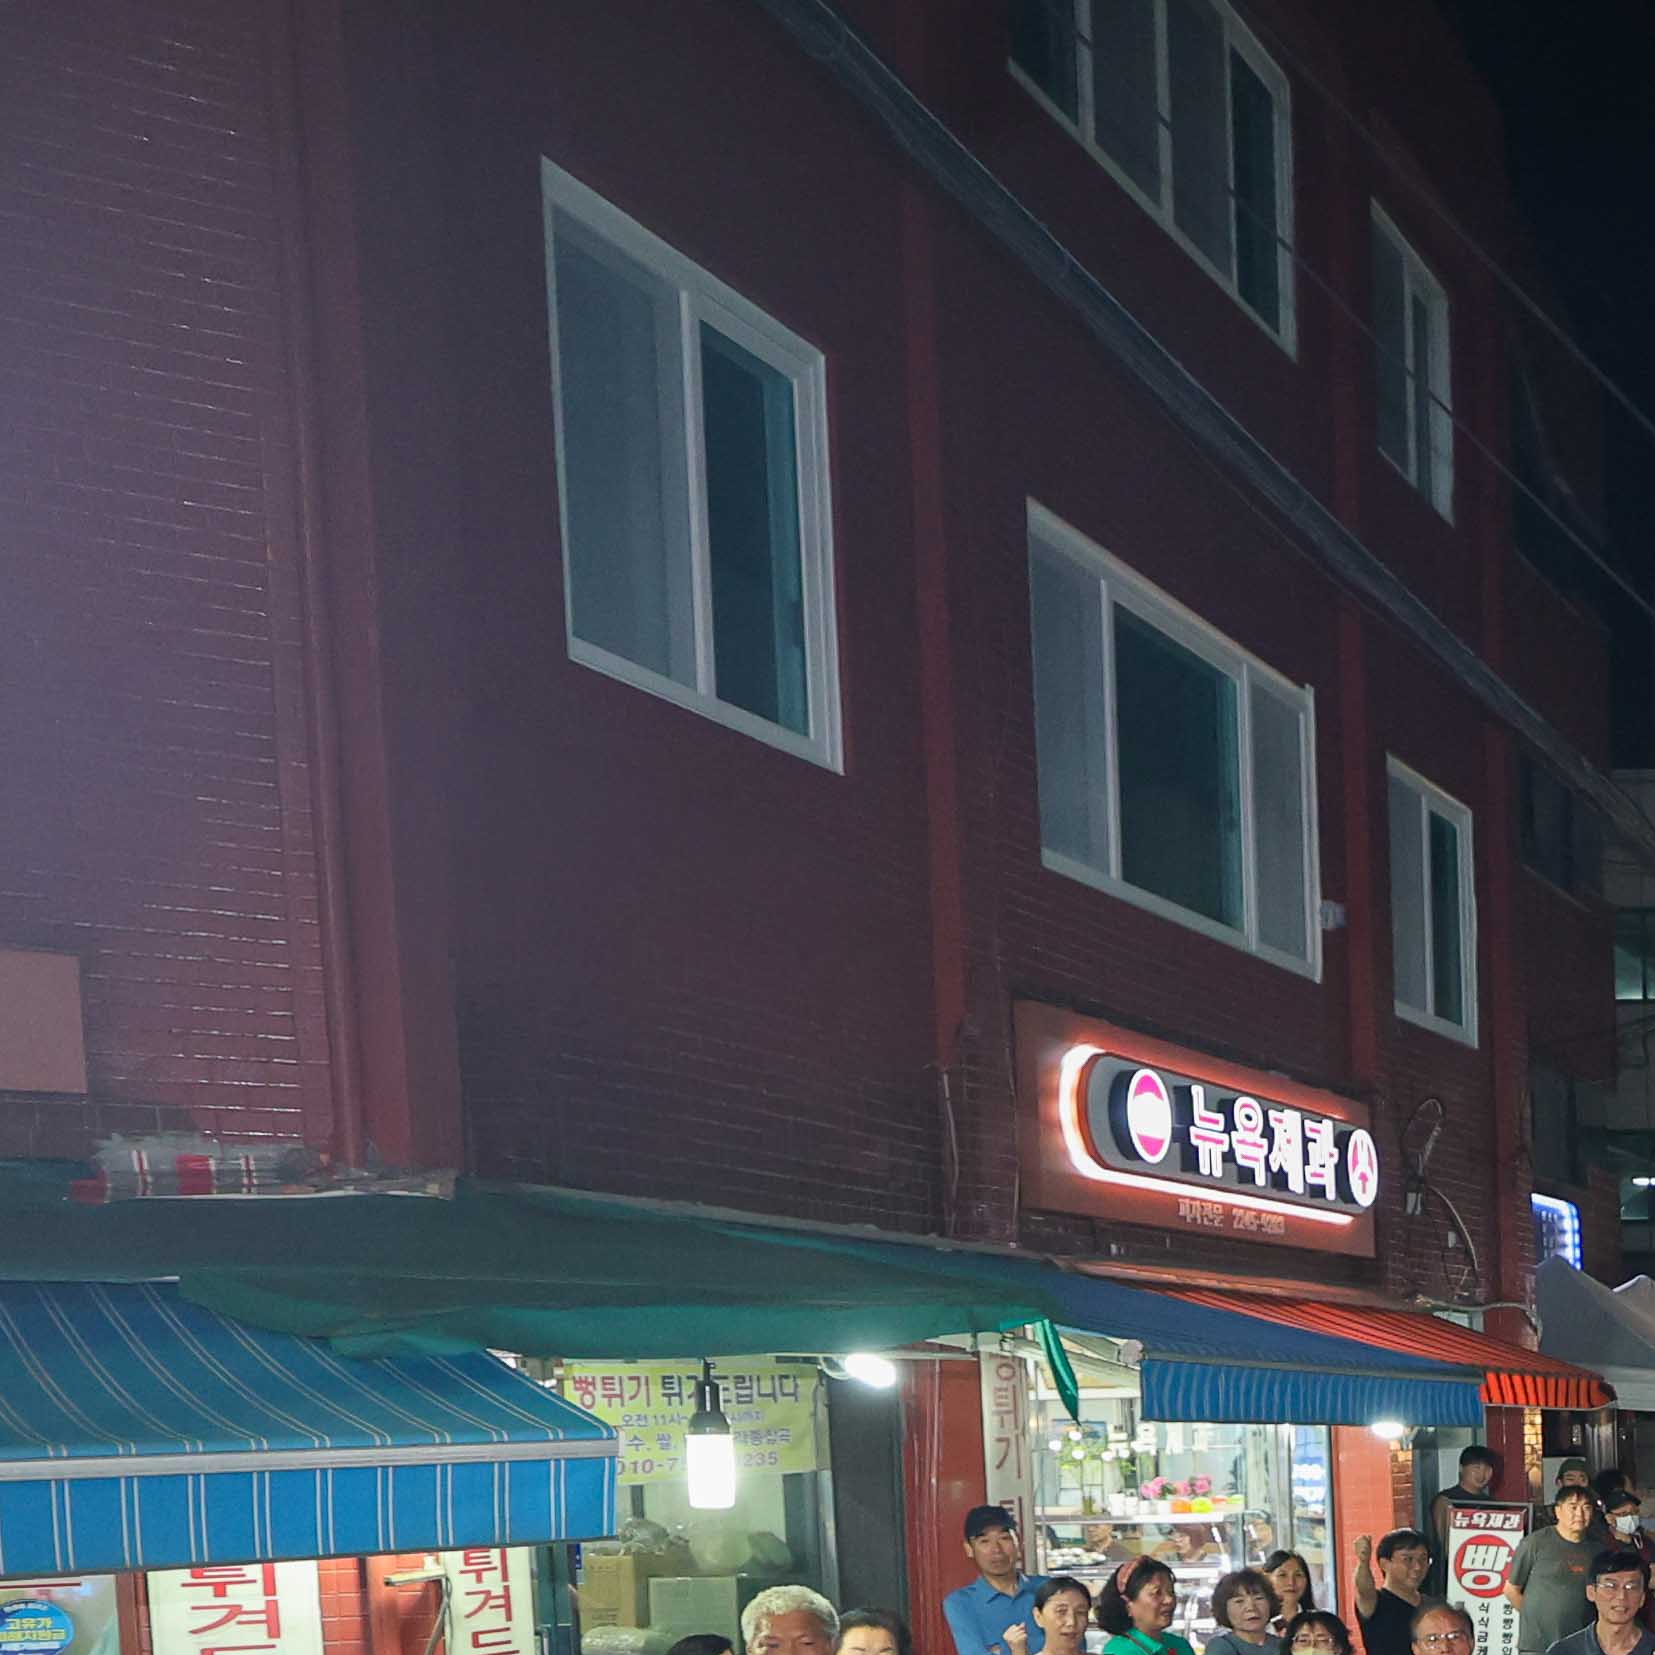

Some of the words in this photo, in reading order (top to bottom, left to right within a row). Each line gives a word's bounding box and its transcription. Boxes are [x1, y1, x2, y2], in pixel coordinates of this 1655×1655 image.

[1190, 1084, 1339, 1201] 뉴욕제과
[572, 1375, 650, 1409] 뻥튀기
[622, 1413, 648, 1427] 오전
[1454, 1511, 1520, 1529] 뉴욕제과
[1461, 1544, 1512, 1590] 빵
